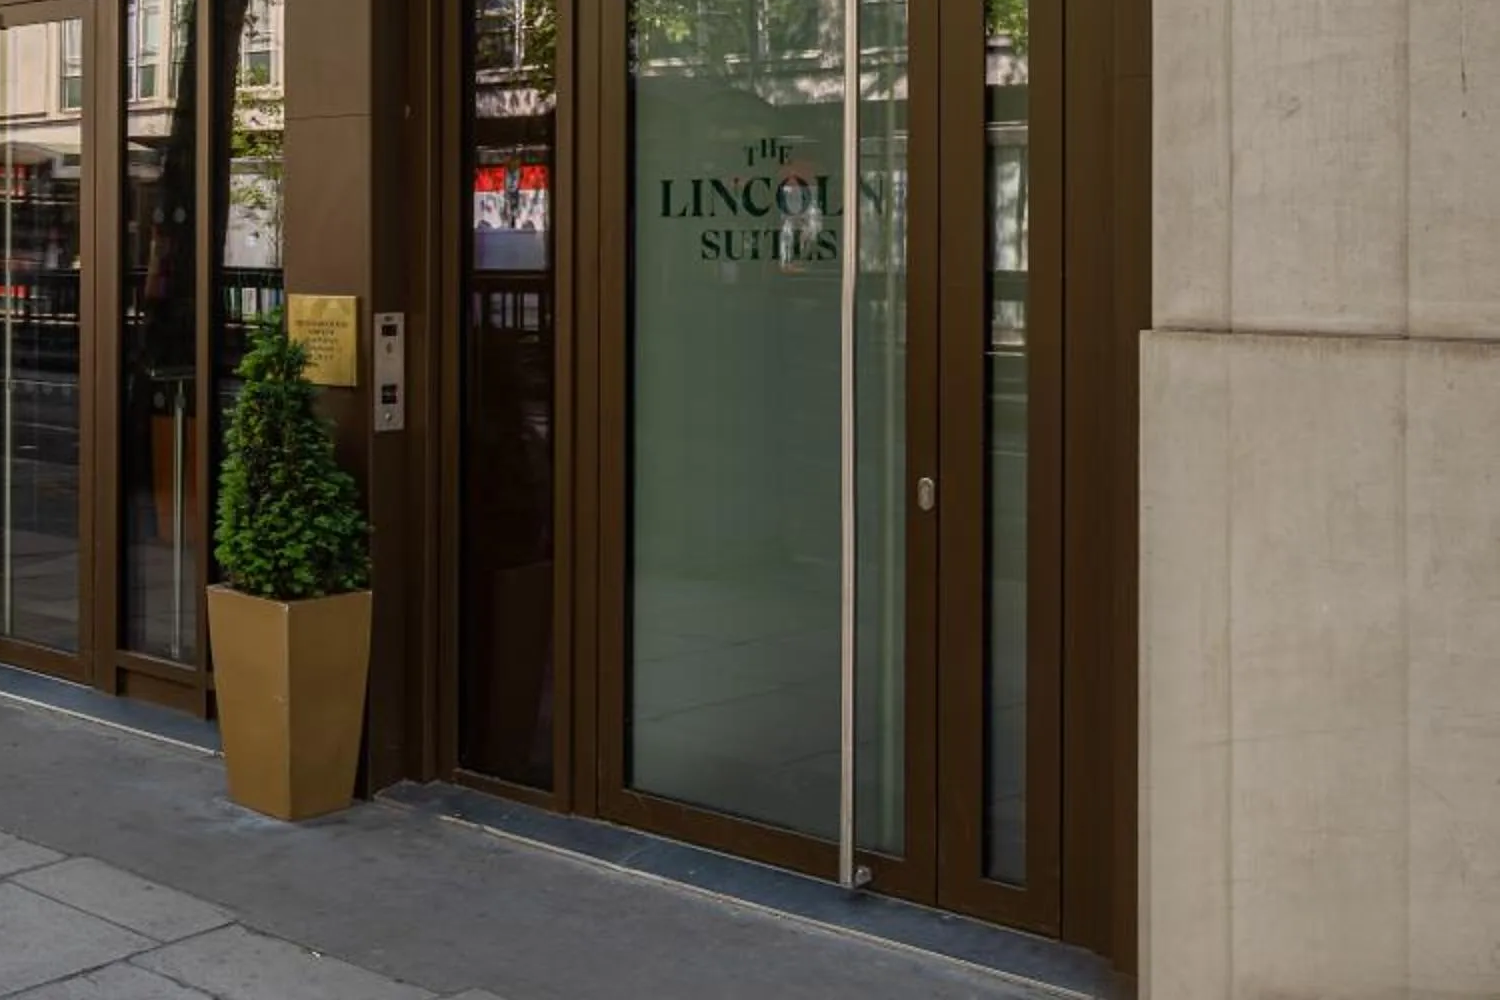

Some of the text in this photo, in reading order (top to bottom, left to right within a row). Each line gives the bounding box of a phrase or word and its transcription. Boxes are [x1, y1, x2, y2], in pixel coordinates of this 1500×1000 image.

[743, 138, 794, 167] THE
[660, 174, 885, 218] LINCOLN
[701, 229, 838, 261] SUITES
